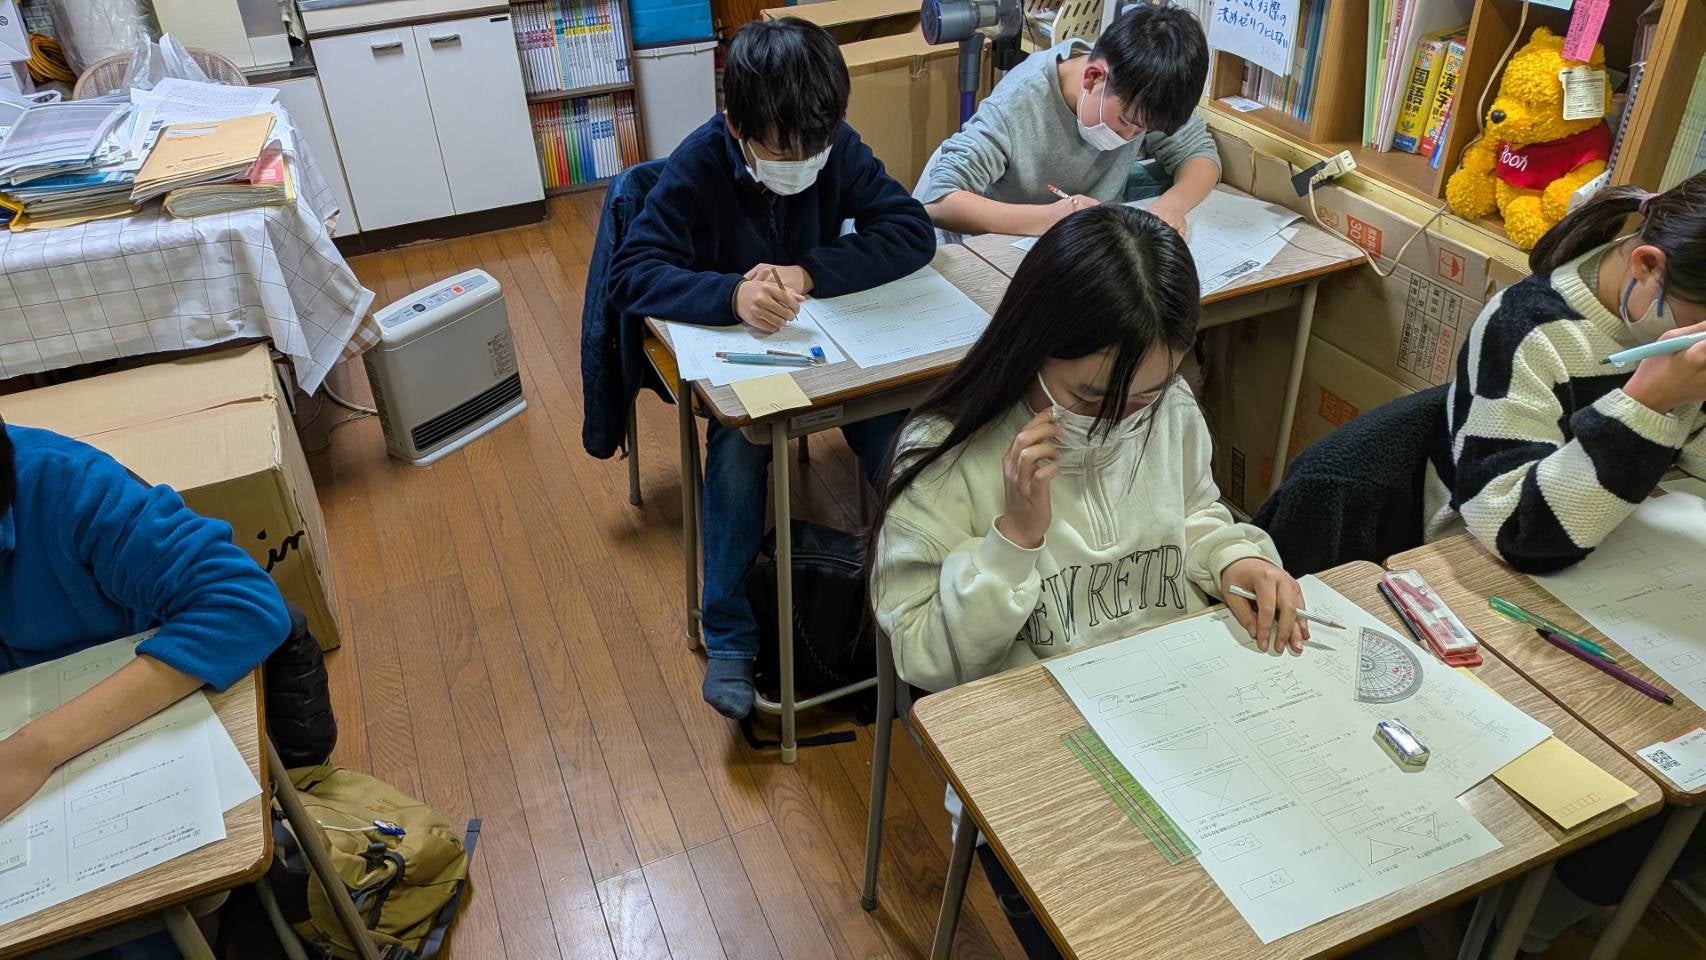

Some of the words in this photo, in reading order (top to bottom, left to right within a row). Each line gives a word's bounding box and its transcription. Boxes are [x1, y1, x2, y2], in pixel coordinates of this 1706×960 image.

[1500, 145, 1528, 172] Pooh
[1016, 565, 1081, 645] EW
[1088, 545, 1185, 627] RETR
